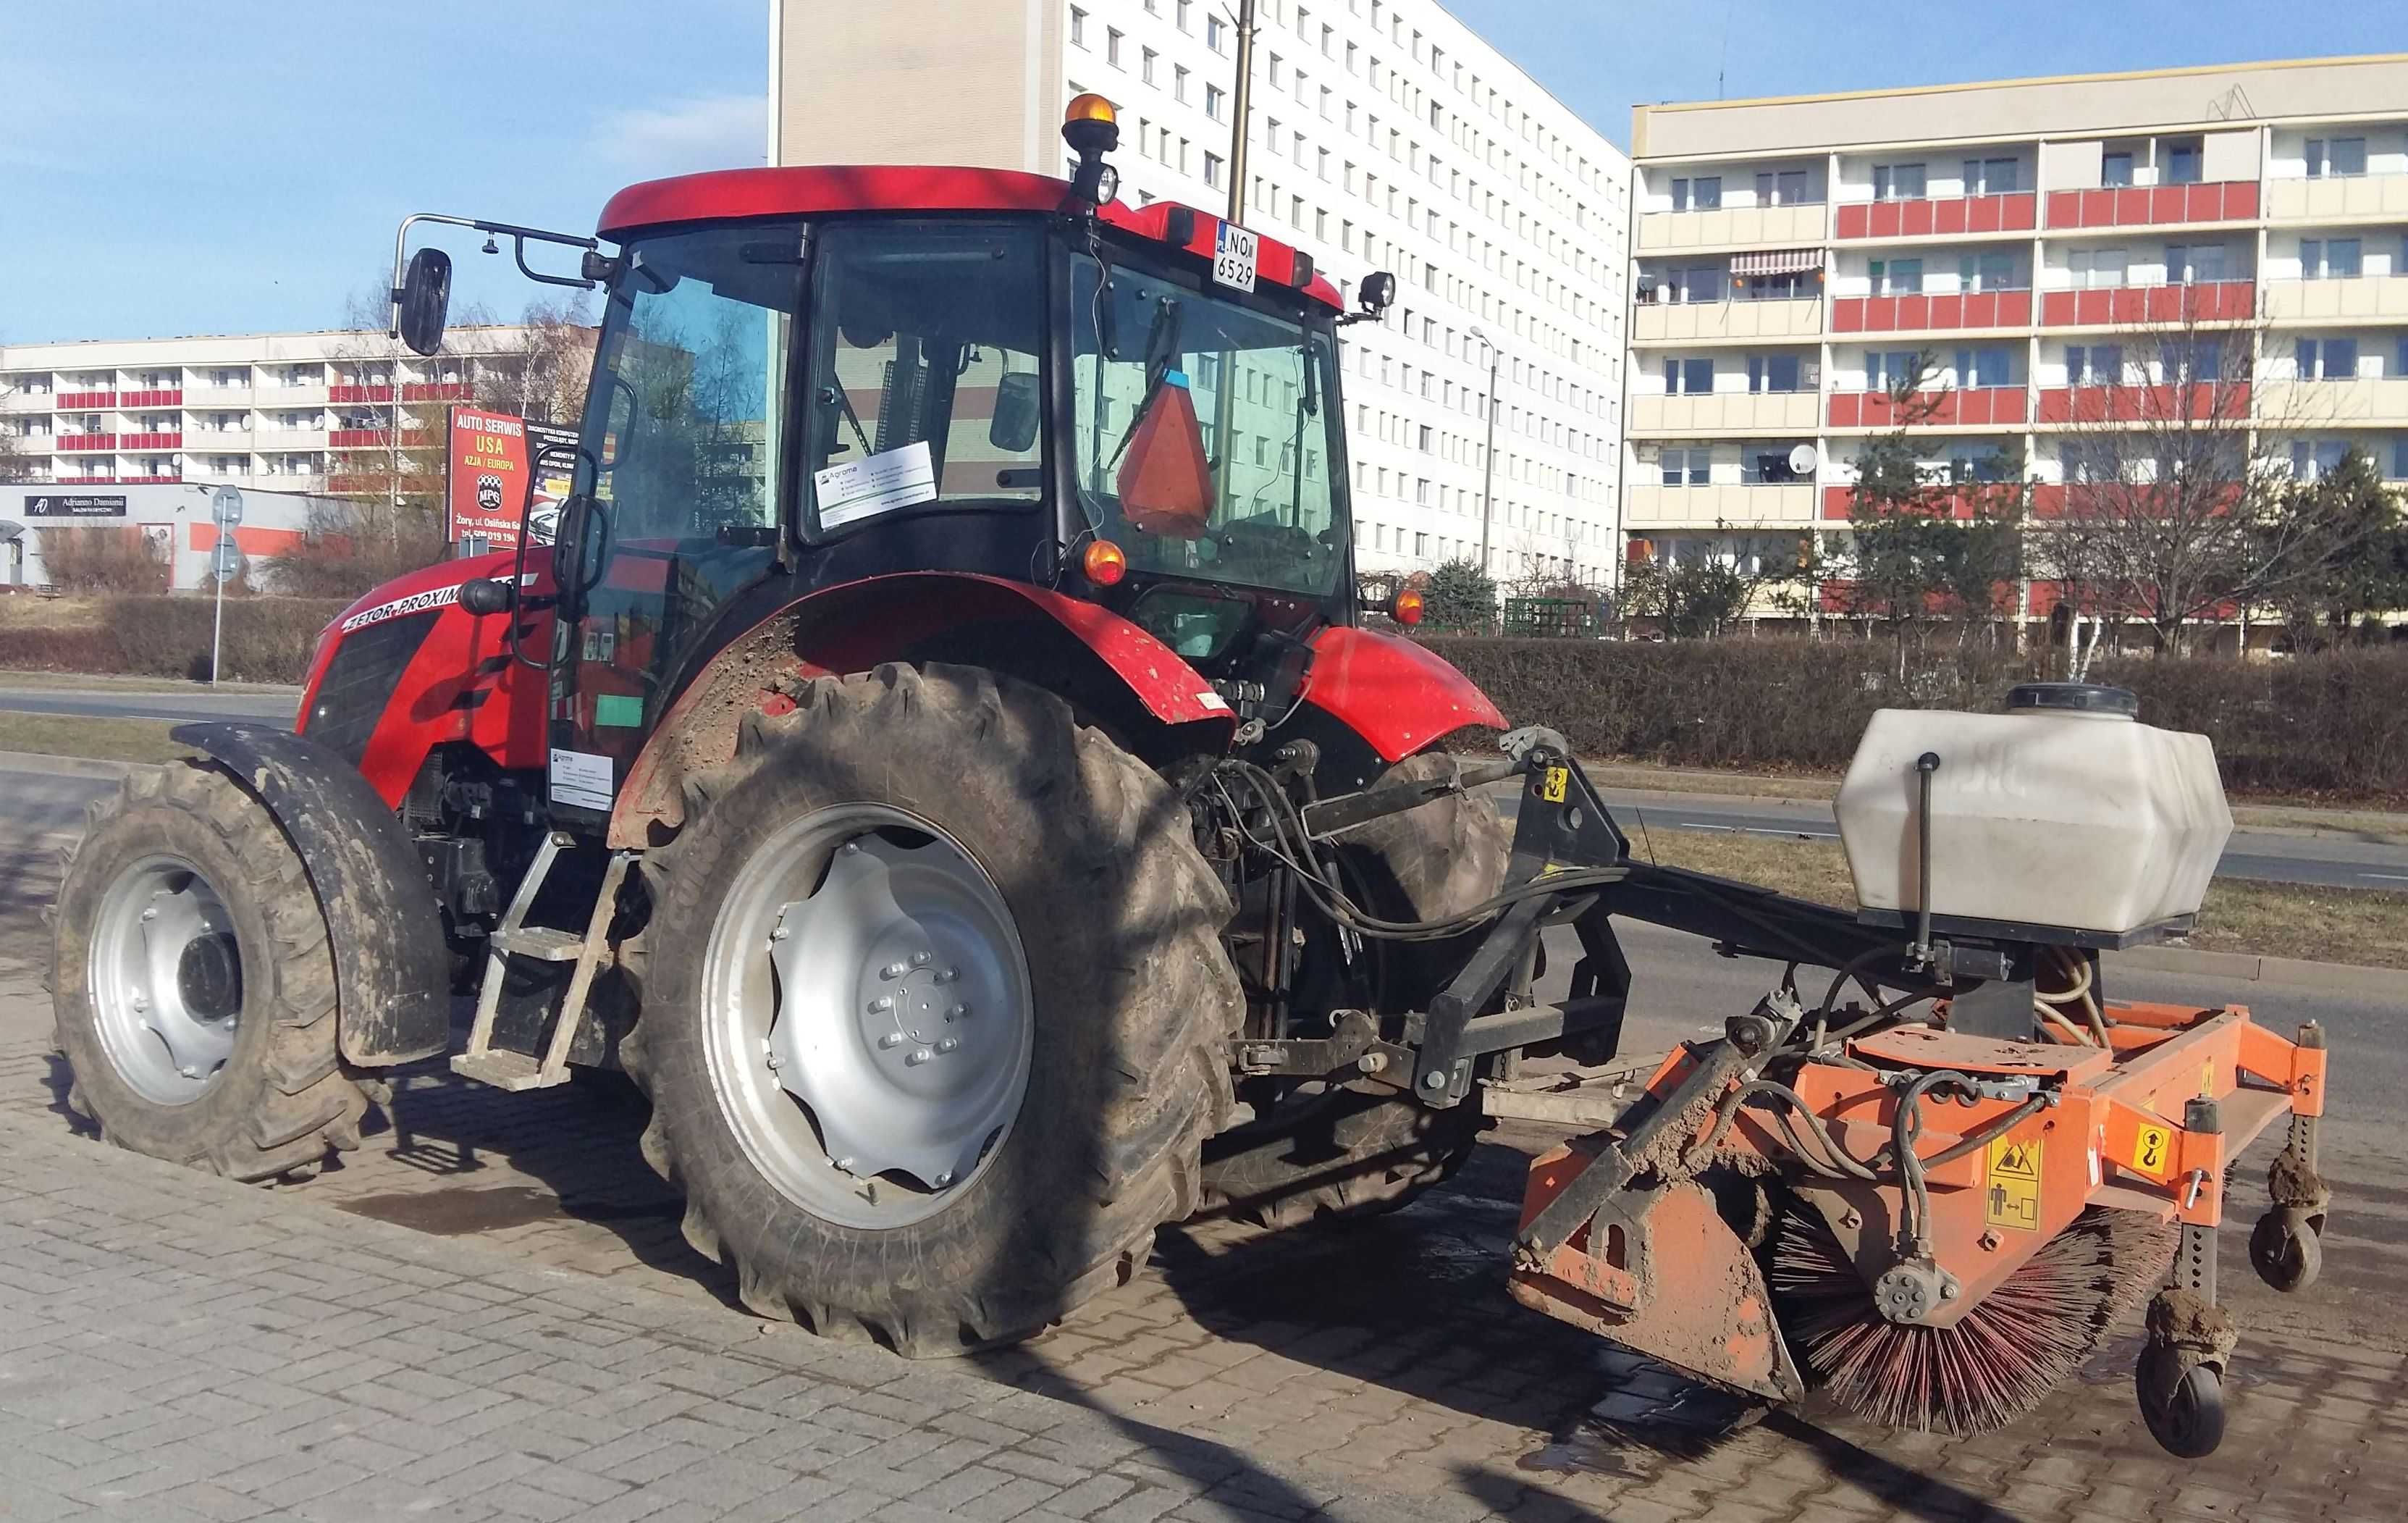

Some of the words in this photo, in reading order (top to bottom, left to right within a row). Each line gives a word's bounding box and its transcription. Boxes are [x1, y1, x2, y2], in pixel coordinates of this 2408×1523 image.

[1218, 256, 1253, 285] 6529
[456, 414, 484, 431] AUTO
[484, 417, 522, 437] SERWIS
[476, 434, 505, 456] USA
[464, 454, 482, 468] AZJA
[487, 458, 515, 471] EUROPA
[829, 466, 857, 479] Agroma
[479, 489, 501, 505] MPG
[455, 512, 475, 528] Żory,
[475, 516, 484, 526] ul.
[484, 517, 511, 530] Osińska
[511, 520, 521, 530] 6a
[487, 531, 502, 542] 019
[502, 532, 516, 543] 194
[347, 603, 395, 631] ZETOR
[397, 587, 458, 614] PROXIM
